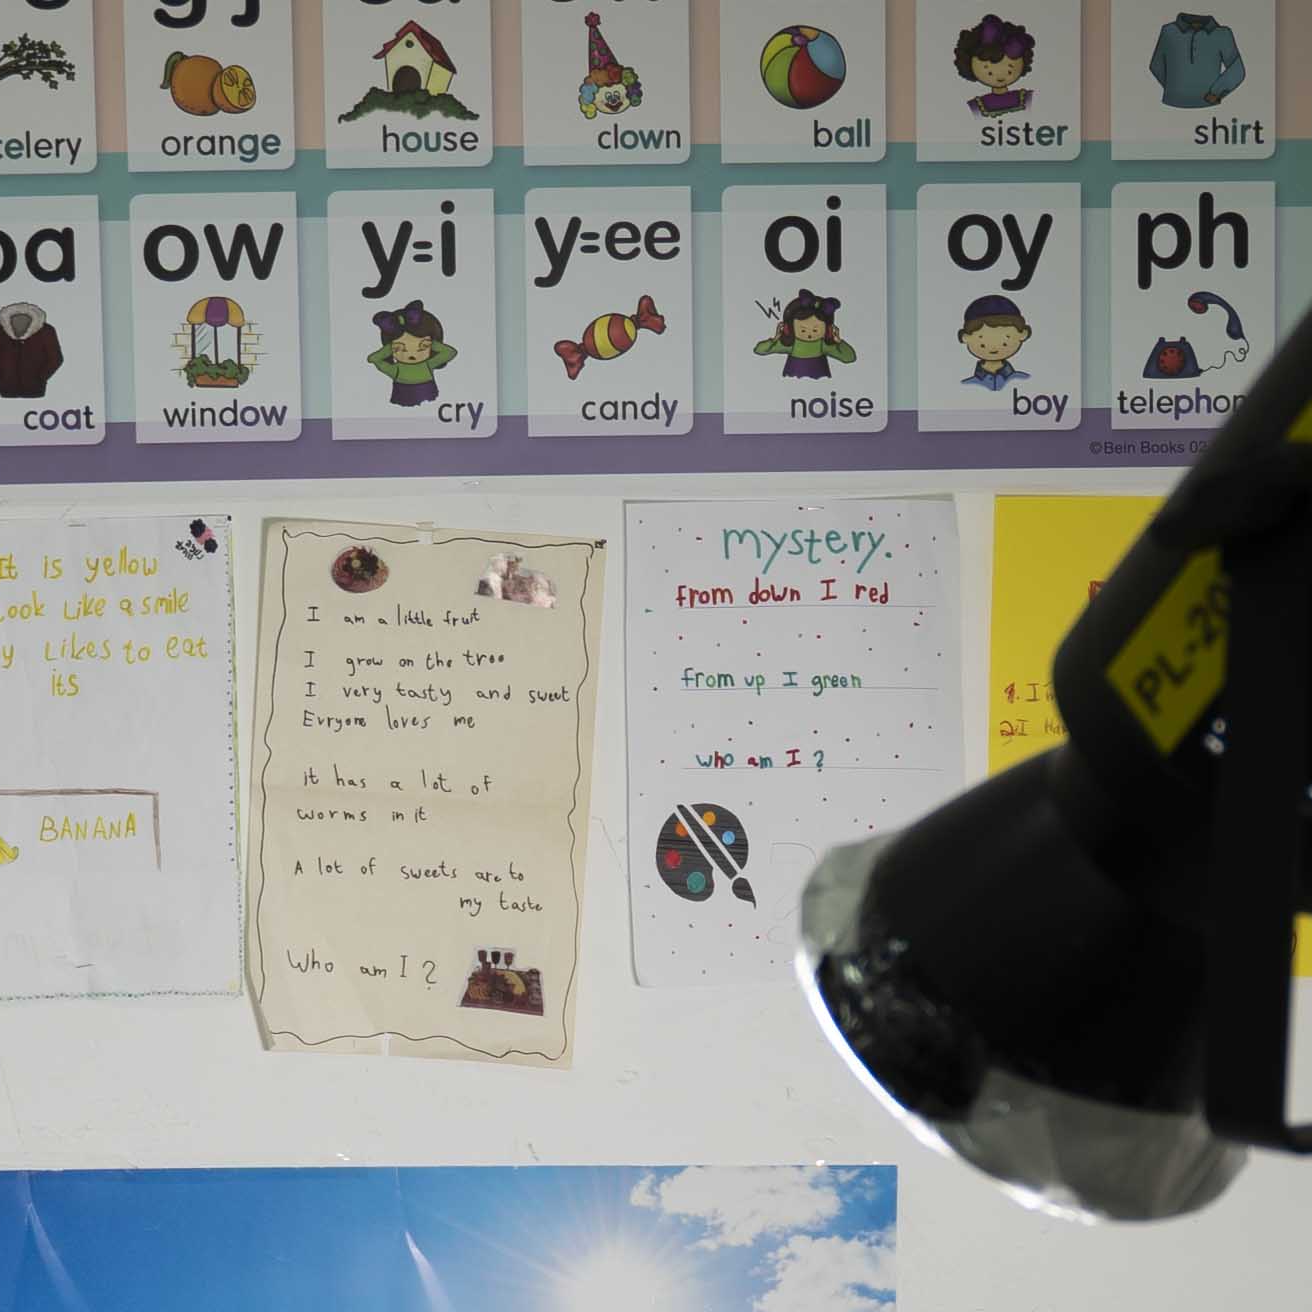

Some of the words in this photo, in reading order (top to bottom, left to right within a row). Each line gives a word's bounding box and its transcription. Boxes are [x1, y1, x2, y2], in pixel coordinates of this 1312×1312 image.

[383, 124, 478, 152] house
[598, 123, 681, 150] clown
[814, 118, 870, 148] ball
[981, 118, 1068, 146] sister
[1195, 117, 1264, 144] shirt
[161, 134, 281, 163] orange
[765, 195, 841, 273] oi
[1138, 192, 1248, 290] ph
[144, 223, 283, 282] ow
[948, 213, 1053, 291] oy
[163, 399, 287, 427] window
[438, 400, 483, 428] cry
[581, 395, 678, 426] candy
[791, 391, 873, 418] noise
[1013, 388, 1068, 421] boy
[1117, 387, 1246, 420] telephon
[24, 406, 95, 430] coat
[1141, 441, 1184, 453] Books
[43, 555, 63, 580] is
[84, 546, 157, 583] yellow
[120, 598, 134, 617] a
[141, 588, 188, 615] smile
[676, 585, 733, 608] from
[749, 577, 800, 604] down
[820, 579, 837, 601] I
[855, 582, 888, 604] red
[307, 606, 320, 621] I
[344, 616, 365, 624] am
[397, 604, 433, 627] little
[443, 608, 480, 626] fruit
[123, 640, 152, 665] to
[166, 636, 208, 659] eat
[1135, 576, 1231, 718] PL-20
[304, 651, 315, 668] I
[346, 657, 383, 676] grow
[399, 659, 414, 667] on
[426, 651, 452, 670] the
[305, 682, 316, 697] I
[343, 686, 381, 704] very
[396, 682, 451, 706] tasty
[476, 685, 510, 700] and
[681, 668, 735, 690] from
[744, 675, 765, 696] up
[783, 672, 798, 687] I
[811, 674, 862, 696] green
[386, 704, 430, 730] loves
[454, 717, 475, 728] me
[696, 751, 734, 769] who
[748, 756, 773, 769] am
[786, 749, 801, 767] I
[334, 764, 366, 788] has
[390, 781, 403, 791] a
[422, 769, 451, 792] lot
[471, 775, 492, 795] of
[40, 812, 136, 842] BANANA
[297, 809, 366, 821] worms
[392, 811, 404, 821] in
[294, 860, 303, 875] A
[318, 857, 343, 875] lot
[361, 857, 376, 875] of
[401, 861, 456, 879] sweets
[475, 872, 502, 882] are
[509, 862, 524, 881] to
[460, 897, 482, 917] my
[500, 891, 542, 912] taste
[287, 948, 333, 973] Who
[360, 966, 386, 978] am
[400, 955, 408, 977] I
